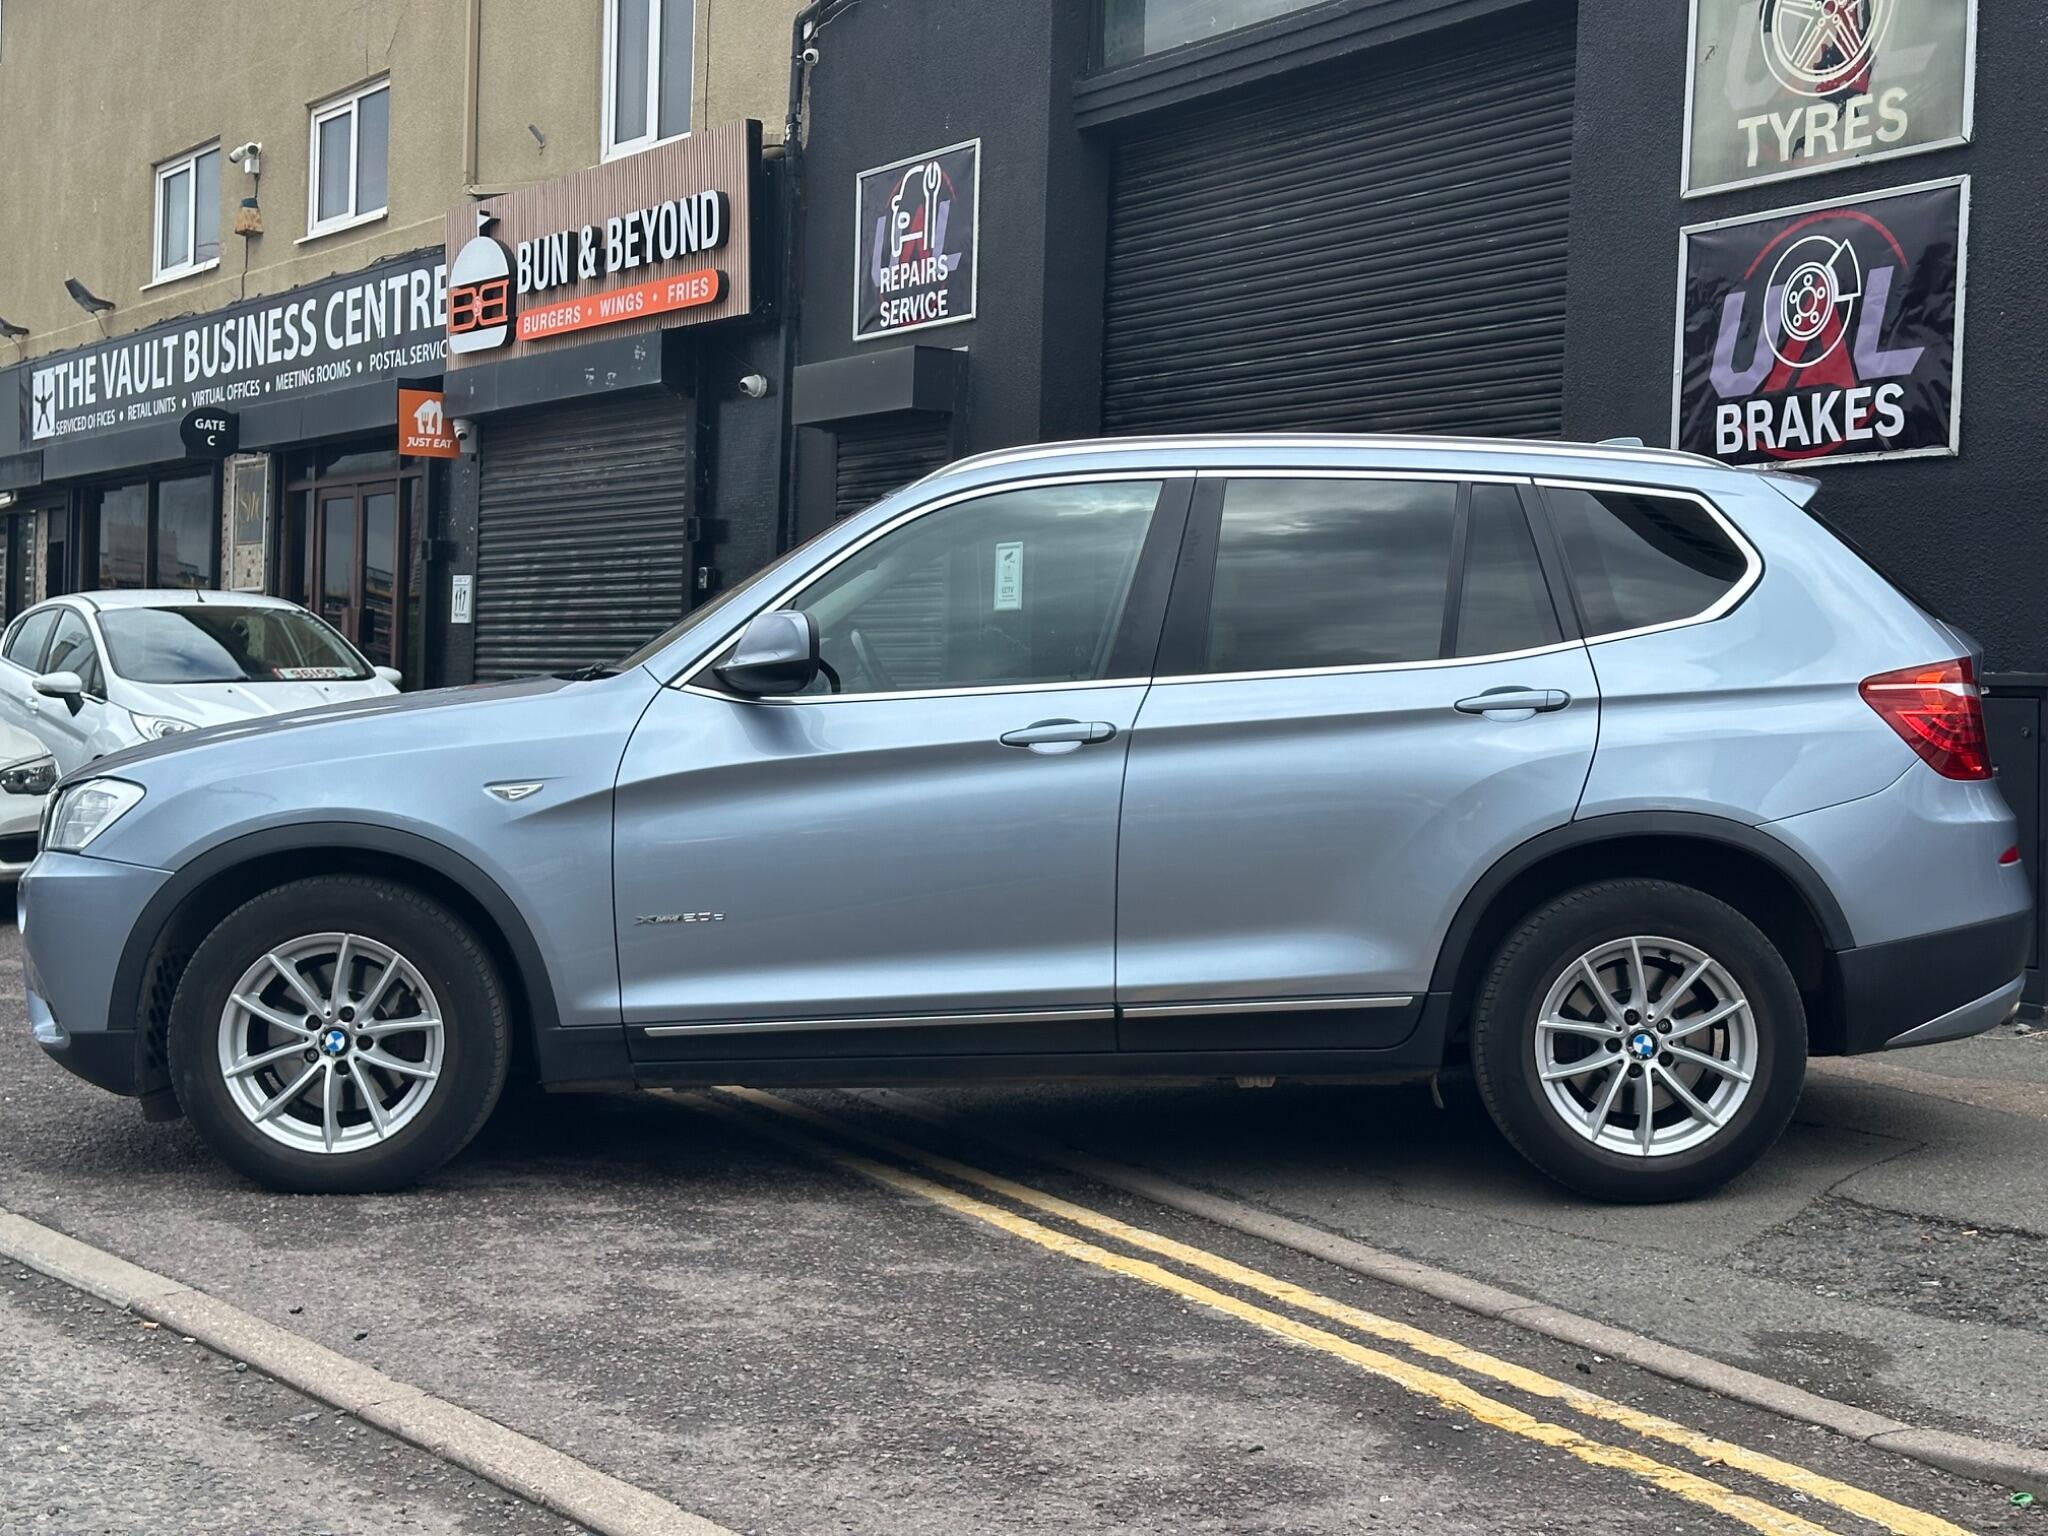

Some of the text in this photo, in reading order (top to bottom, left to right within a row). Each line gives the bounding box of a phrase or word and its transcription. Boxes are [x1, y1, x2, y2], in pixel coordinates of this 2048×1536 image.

[1737, 87, 1908, 168] TYRES
[517, 189, 720, 295] BUN & BEYOND
[880, 254, 949, 294] REPAIRS
[523, 277, 709, 334] BURGERS WINGS FRIES
[879, 289, 948, 328] SERVICE
[55, 264, 447, 411] THE VAULT BUSINESS CENTRE
[55, 415, 87, 436] SERVICED
[127, 402, 152, 421] RETAIL
[153, 396, 177, 416] UNITS
[191, 386, 225, 407] VIRTUAL
[226, 379, 260, 401] OFFICES
[275, 367, 315, 392] MEETING
[316, 359, 351, 383] ROOMS
[369, 347, 408, 372] POSTAL
[410, 339, 448, 365] SERVIC
[195, 418, 226, 431] GATE
[207, 435, 216, 446] C
[406, 436, 453, 449] JUST EAT
[1716, 382, 1905, 455] BRAKES
